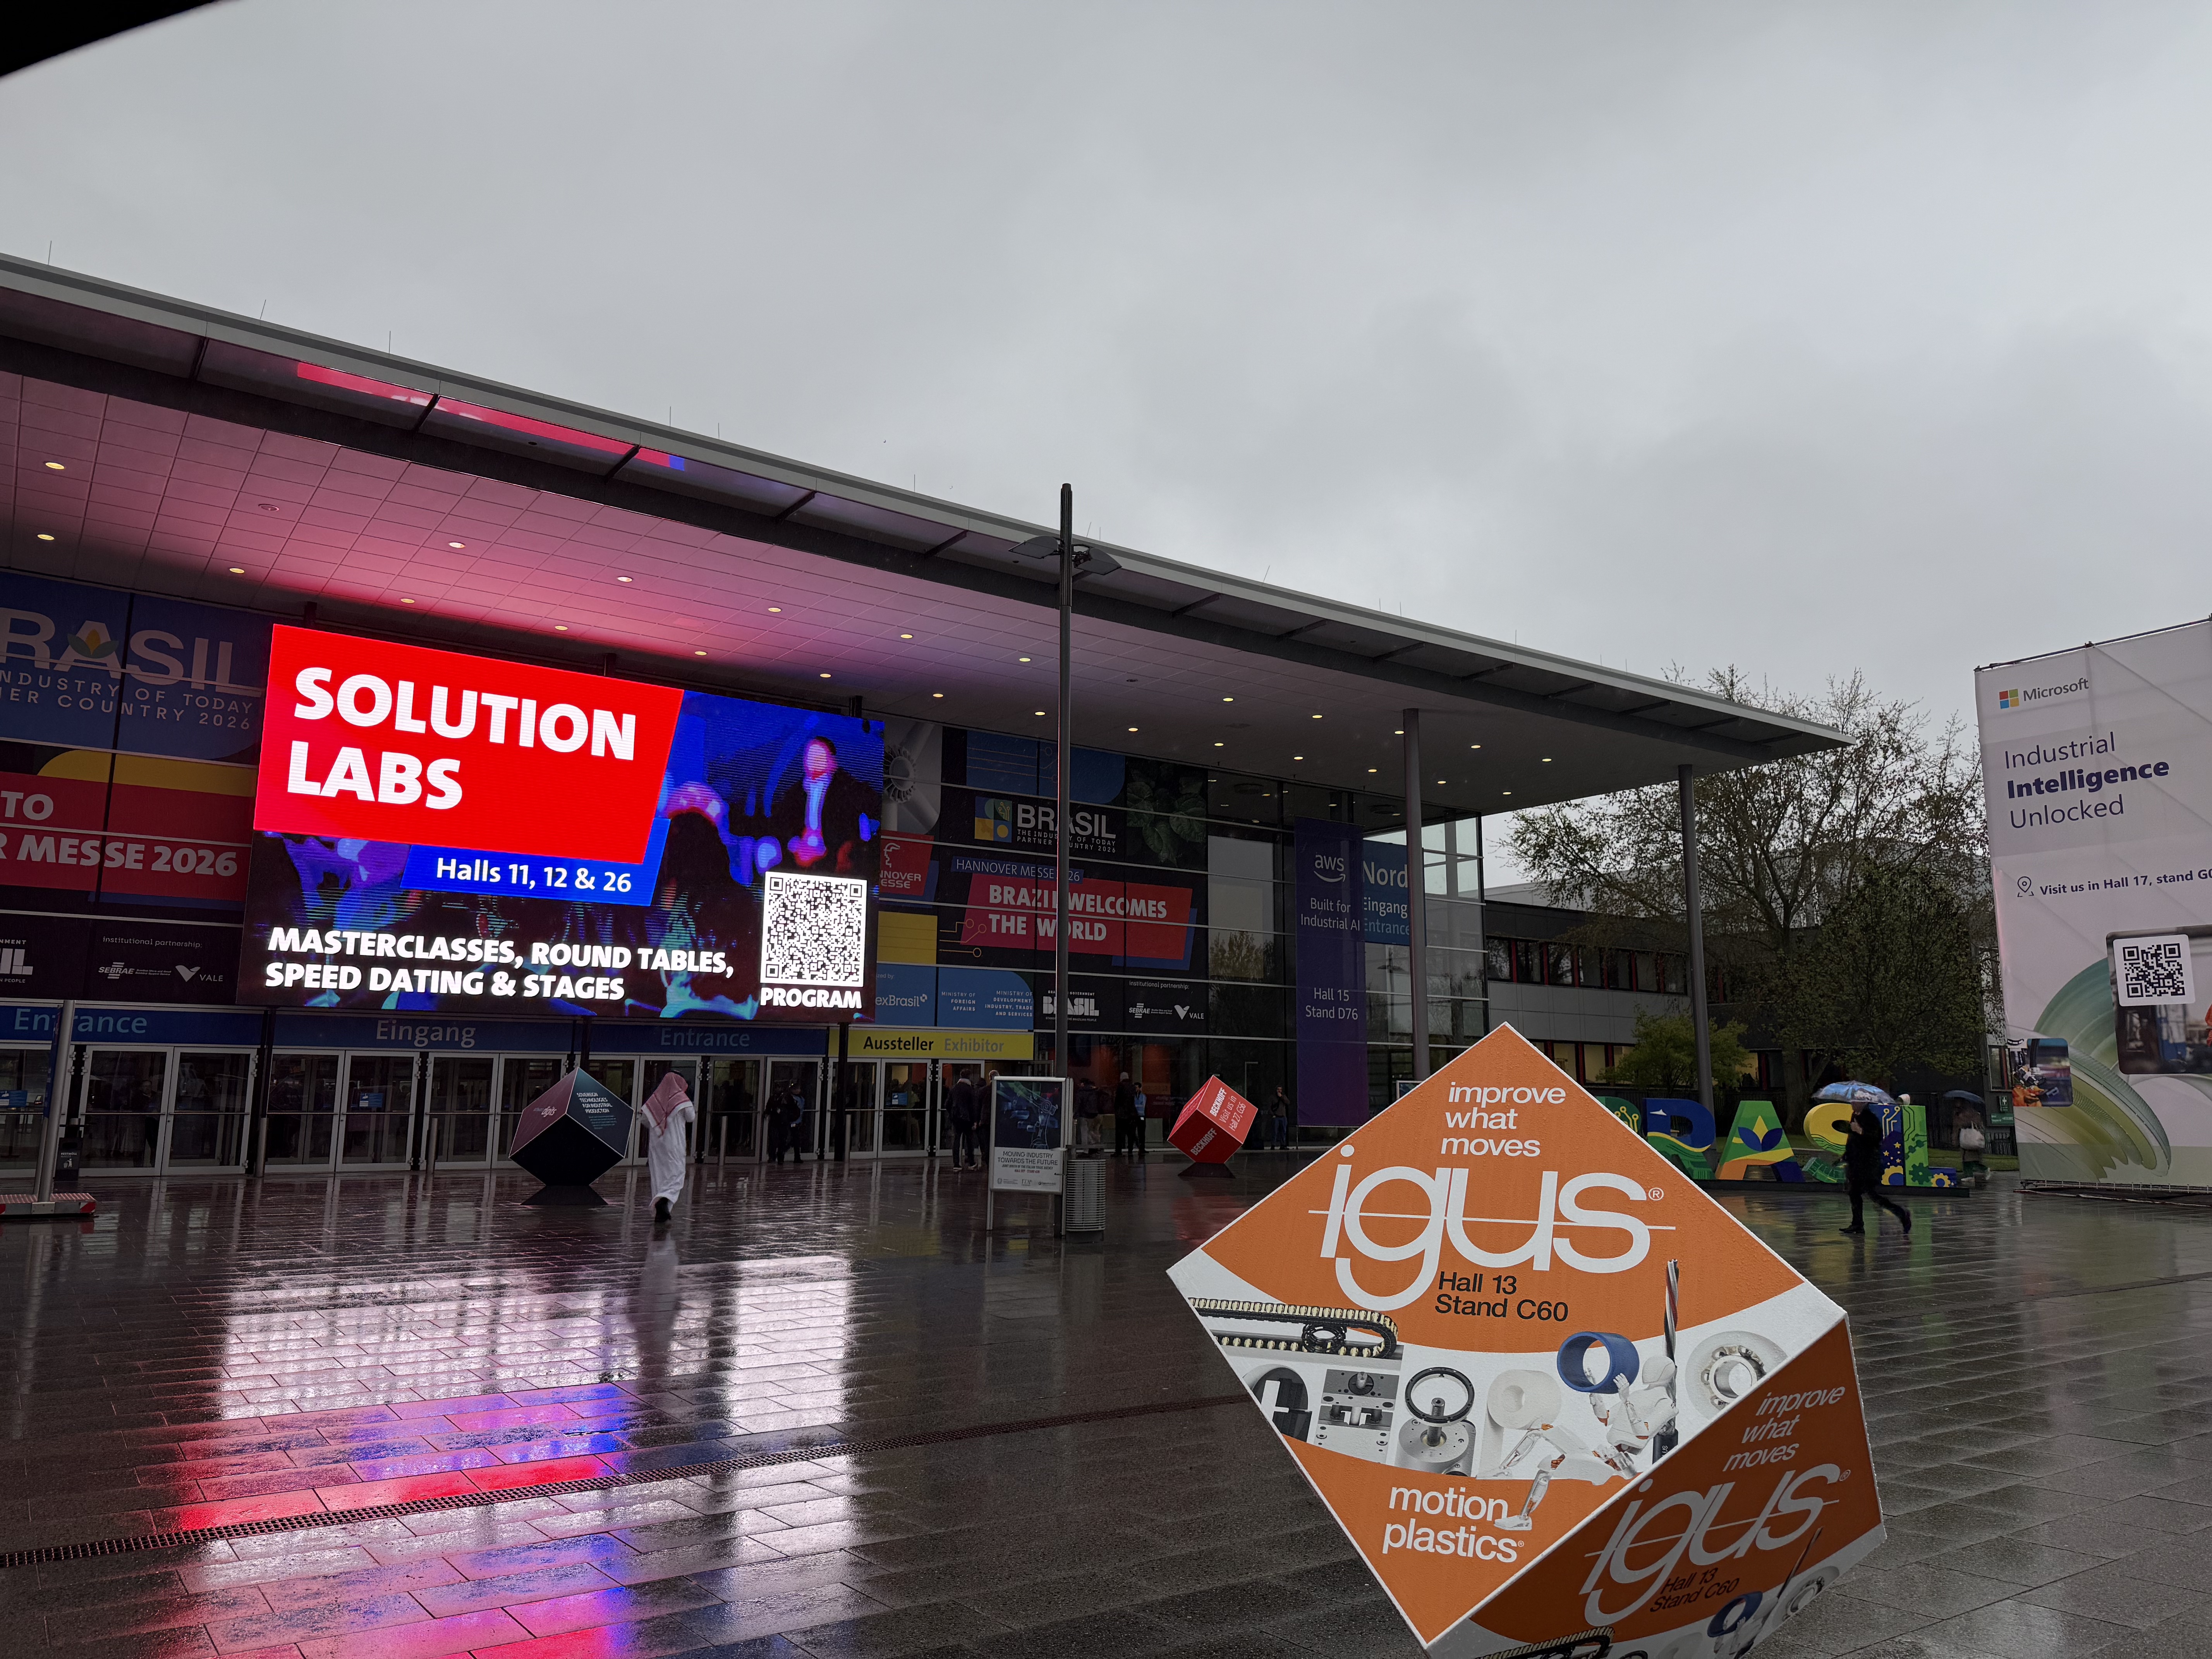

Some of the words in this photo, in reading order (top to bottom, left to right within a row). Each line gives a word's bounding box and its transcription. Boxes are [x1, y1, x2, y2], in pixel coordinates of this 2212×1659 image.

[135, 688, 165, 702] OF
[183, 694, 252, 714] TODAY
[2023, 677, 2089, 702] Microsoft
[58, 695, 184, 721] COUNTRY
[199, 712, 250, 730] 2026
[294, 667, 636, 761] SOLUTION
[2005, 731, 2116, 769] Industrial
[287, 740, 462, 810] LABS
[2007, 761, 2170, 799] Intelligence
[0, 790, 53, 820] TO
[2010, 794, 2124, 829] Unlocked
[1017, 836, 1052, 845] PARTNER
[1034, 831, 1072, 841] INDUSY
[1091, 838, 1116, 846] TODAY
[17, 834, 145, 870] MESSE
[151, 845, 237, 876] 2026
[1315, 854, 1344, 871] aws
[436, 857, 501, 883] Halls
[509, 864, 536, 889] 11,
[544, 867, 567, 888] 12
[575, 867, 596, 890] &
[604, 871, 632, 893] 26
[957, 859, 1017, 875] HANNOVER
[1020, 866, 1054, 879] MESSE
[1363, 860, 1408, 888] Nord
[2040, 884, 2067, 895] Visit
[2071, 884, 2084, 892] us
[2088, 881, 2099, 891] in
[2104, 876, 2128, 889] Hall
[2133, 875, 2152, 887] 17,
[2156, 870, 2193, 884] stand
[1068, 892, 1167, 919] WELCOMES
[1310, 897, 1334, 911] Built
[1336, 900, 1351, 913] for
[1364, 896, 1408, 919] Eingang
[988, 914, 1026, 935] THE
[1037, 918, 1106, 941] WRLD
[1301, 914, 1348, 930] Industrial
[1350, 919, 1360, 931] AI
[103, 936, 153, 945] institutional
[268, 927, 524, 969] MASTERCLASSES,
[531, 942, 631, 969] ROUND
[637, 948, 734, 978] TABLES,
[265, 962, 362, 990] SPEED
[369, 967, 484, 995] DATING
[491, 971, 516, 997] &
[523, 975, 624, 1000] STAGES
[1314, 987, 1334, 1000] Hall
[1337, 989, 1349, 1001] 15
[760, 988, 862, 1009] PROGRAM
[14, 1008, 147, 1034] Enance
[1305, 1005, 1334, 1018] Stand
[1338, 1007, 1358, 1020] D76
[376, 1020, 476, 1048] Eingang
[661, 1028, 750, 1047] Entrance
[863, 1036, 934, 1050] Aussteller
[945, 1038, 1004, 1053] Exhibitor
[1209, 1087, 1227, 1117] BECKHOFF
[1448, 1082, 1566, 1108] improve
[1219, 1109, 1231, 1123] Visit
[1226, 1102, 1234, 1110] us
[1445, 1107, 1518, 1130] what
[1190, 1128, 1218, 1156] BECKHOFF
[1441, 1137, 1541, 1157] moves
[1595, 1095, 1957, 1188] RASIL
[1438, 1271, 1482, 1293] Hall
[1492, 1275, 1518, 1295] 13
[1434, 1293, 1508, 1318] Stand
[1516, 1298, 1569, 1322] C60
[1755, 1386, 1845, 1418] improve
[1741, 1415, 1799, 1444] what
[1723, 1442, 1799, 1472] moves
[1389, 1486, 1508, 1521] motion
[1661, 1572, 1696, 1594] Hall
[1700, 1568, 1718, 1584] 13
[1650, 1590, 1701, 1613] Stand
[1704, 1578, 1740, 1599] C60
